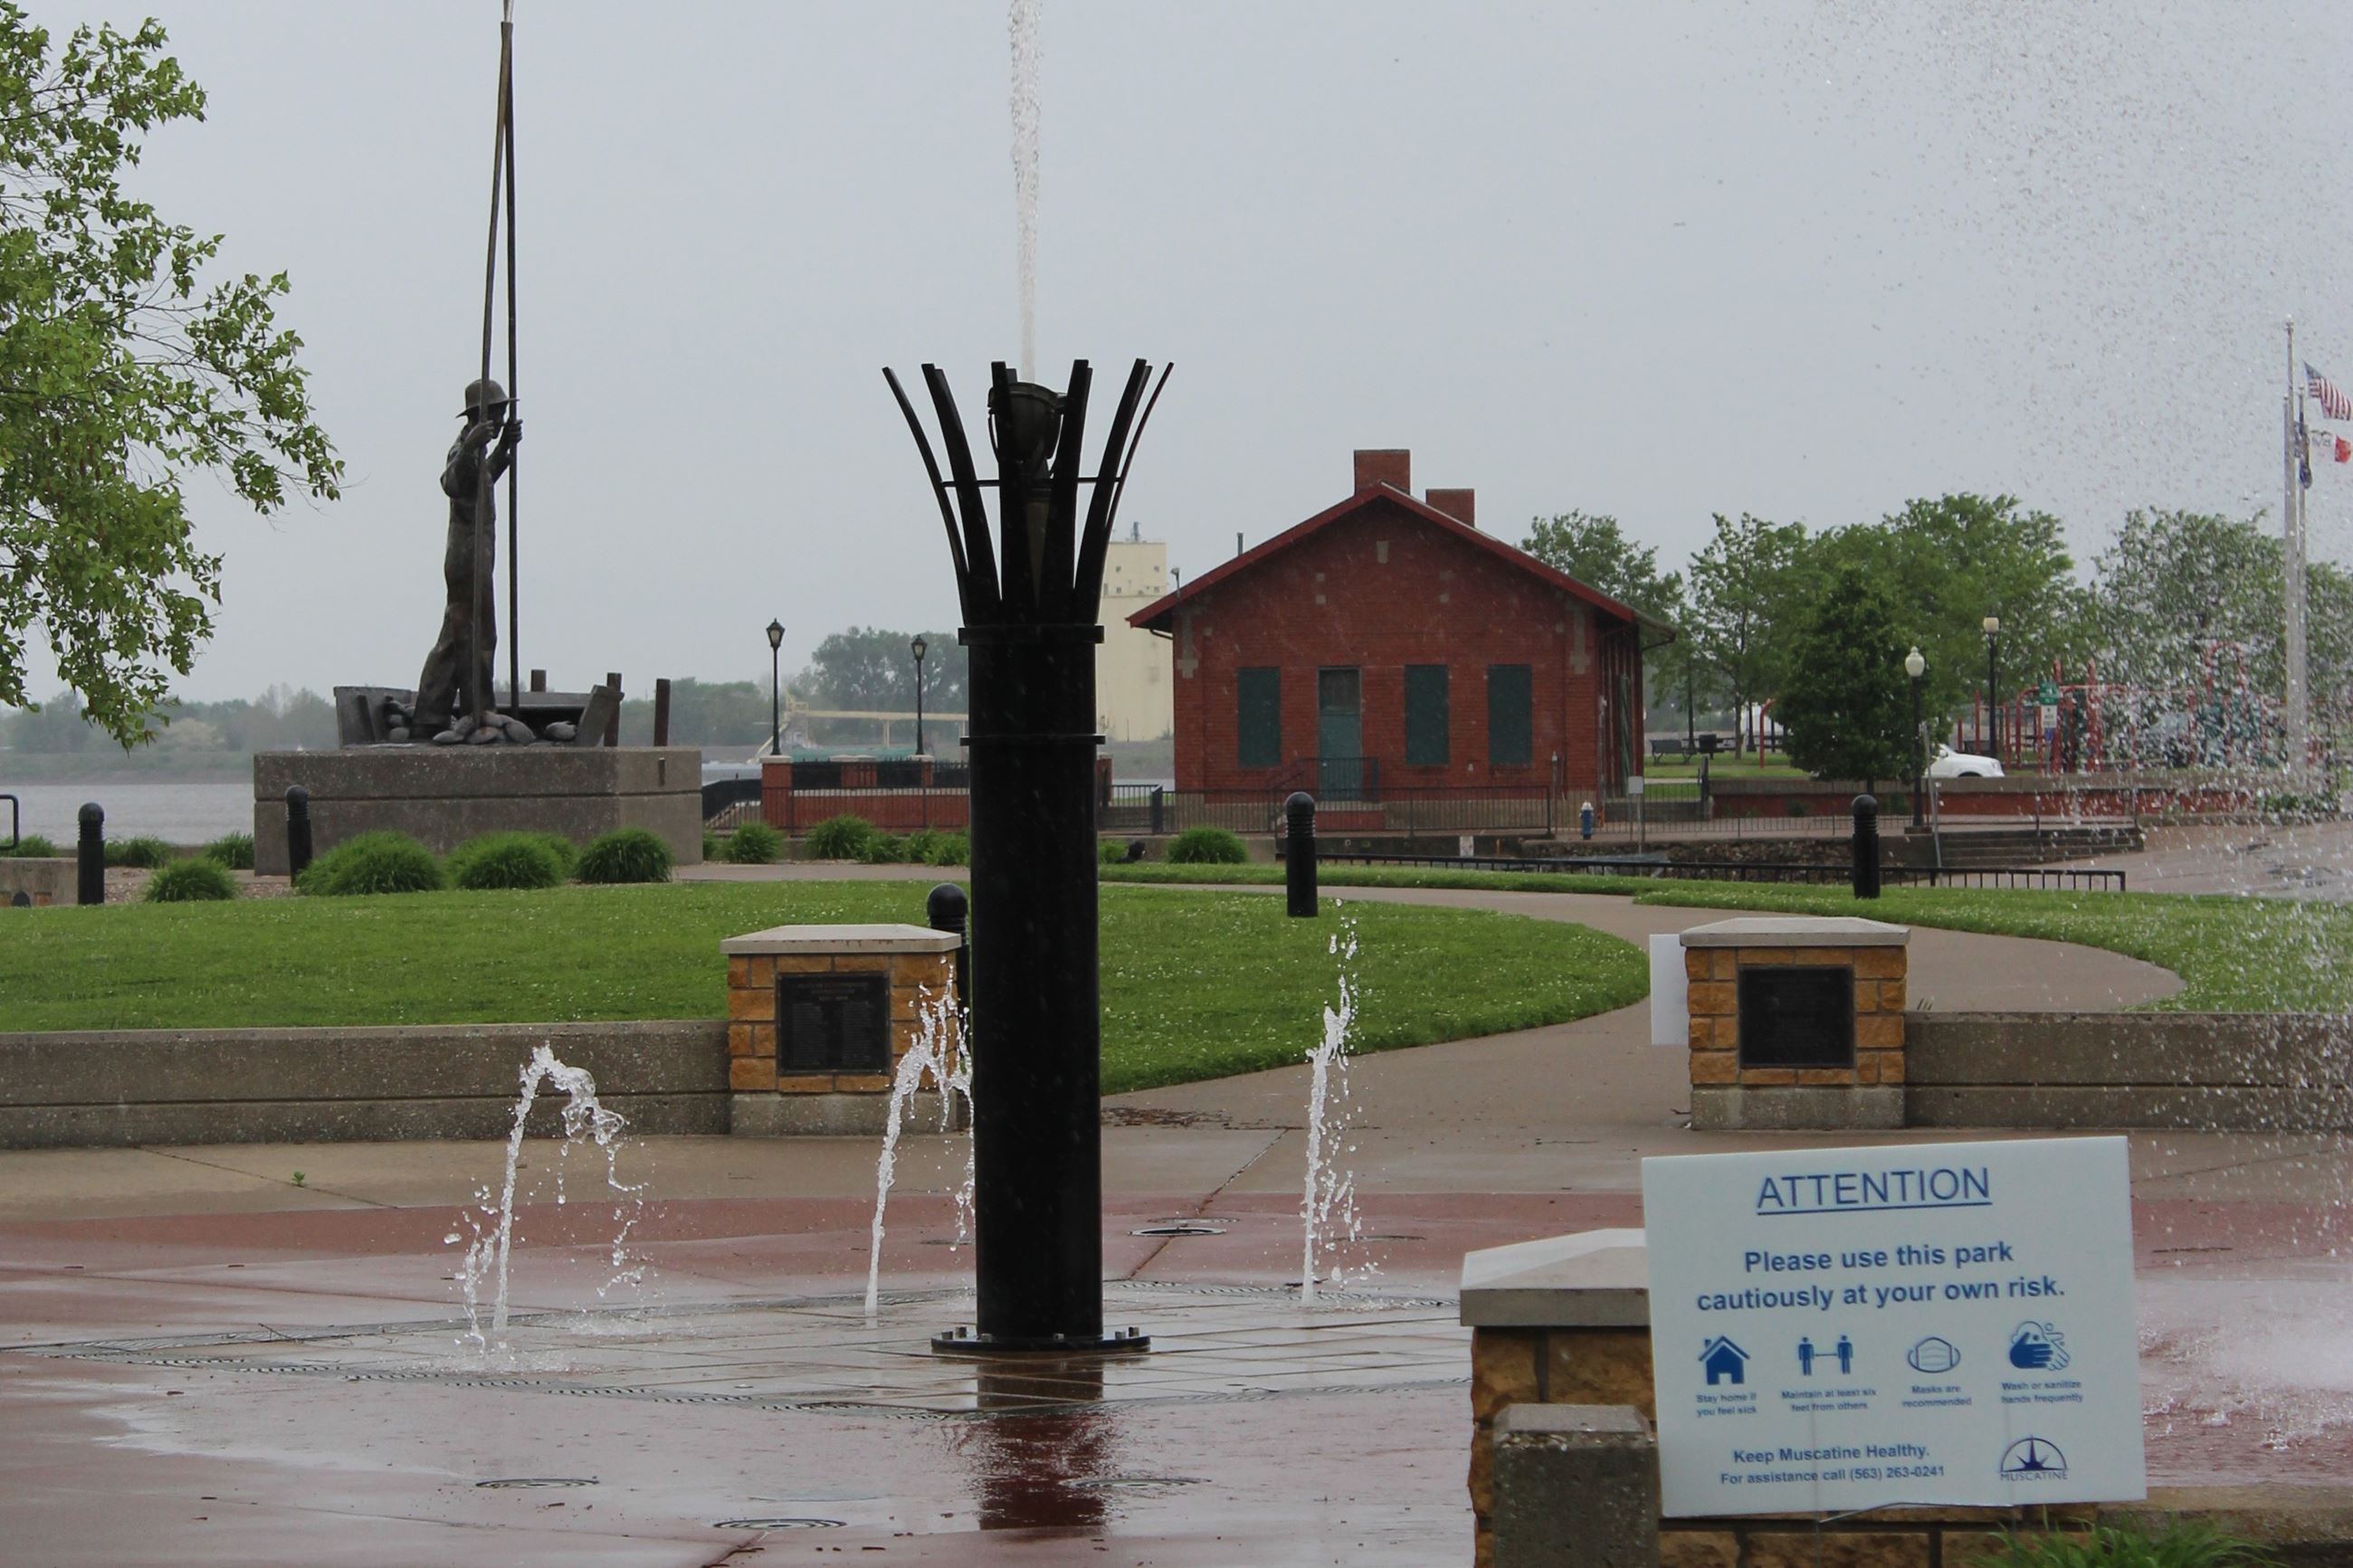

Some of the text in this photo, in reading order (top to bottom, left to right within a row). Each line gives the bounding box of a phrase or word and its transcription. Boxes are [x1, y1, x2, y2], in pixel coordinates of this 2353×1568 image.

[1758, 1167, 1990, 1208] ATTENTION
[1745, 1240, 2014, 1273] Please use this park
[1697, 1276, 2065, 1312] cautiously at your own risk.
[1911, 1385, 1943, 1393] Masks
[2001, 1382, 2029, 1391] Wash
[2044, 1380, 2082, 1389] sanitize
[1696, 1394, 1718, 1404] Stay
[1720, 1393, 1748, 1402] home
[1781, 1391, 1823, 1400] Maintain
[1837, 1389, 1860, 1397] least
[1862, 1388, 1877, 1396] six
[2001, 1393, 2082, 1403] hands frequently
[1791, 1402, 1868, 1412] feet from others
[1902, 1397, 1972, 1408] recommended
[1696, 1405, 1757, 1418] you feel sick
[1734, 1443, 1929, 1464] Keep Muscatine Healthy.
[1720, 1466, 1945, 1484] For assistance call (563) 263-0241
[2000, 1471, 2068, 1481] MUSCATINE
